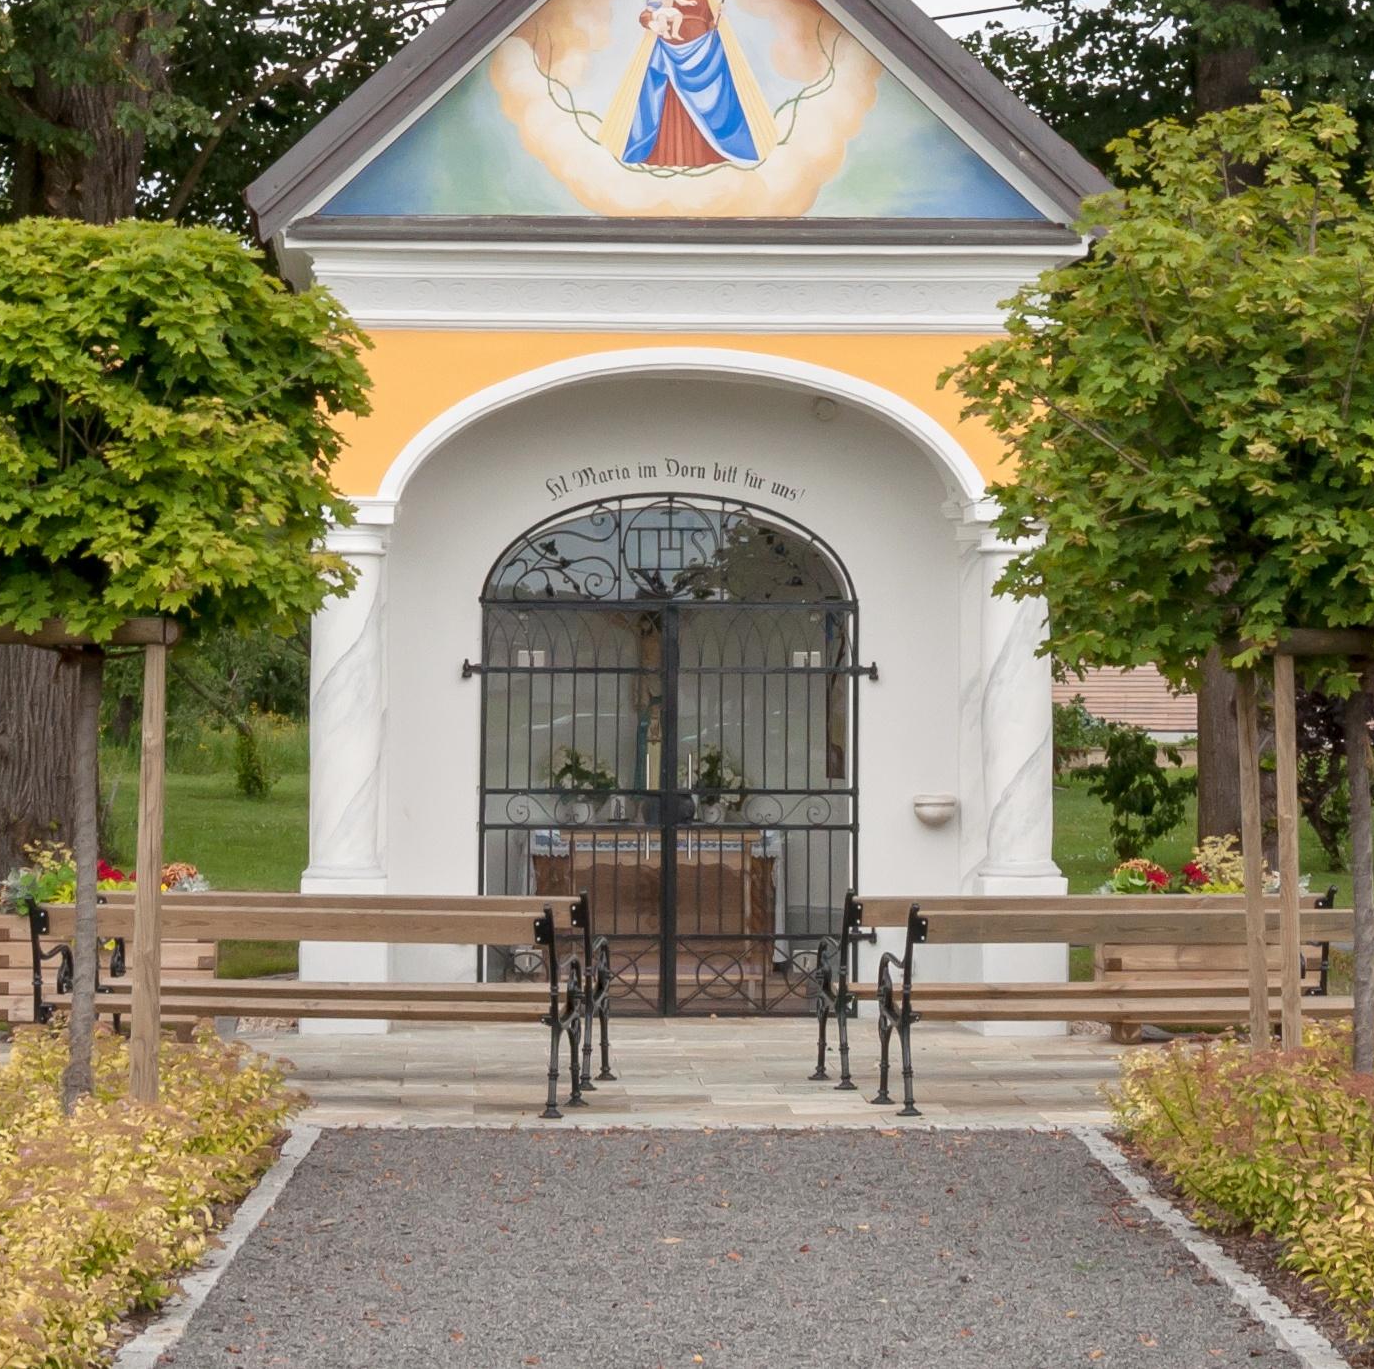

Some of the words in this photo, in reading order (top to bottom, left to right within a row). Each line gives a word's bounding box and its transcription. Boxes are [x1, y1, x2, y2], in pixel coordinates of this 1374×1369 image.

[572, 466, 630, 488] Maria
[638, 462, 657, 478] im
[665, 458, 705, 479] Dorn
[744, 468, 766, 489] für
